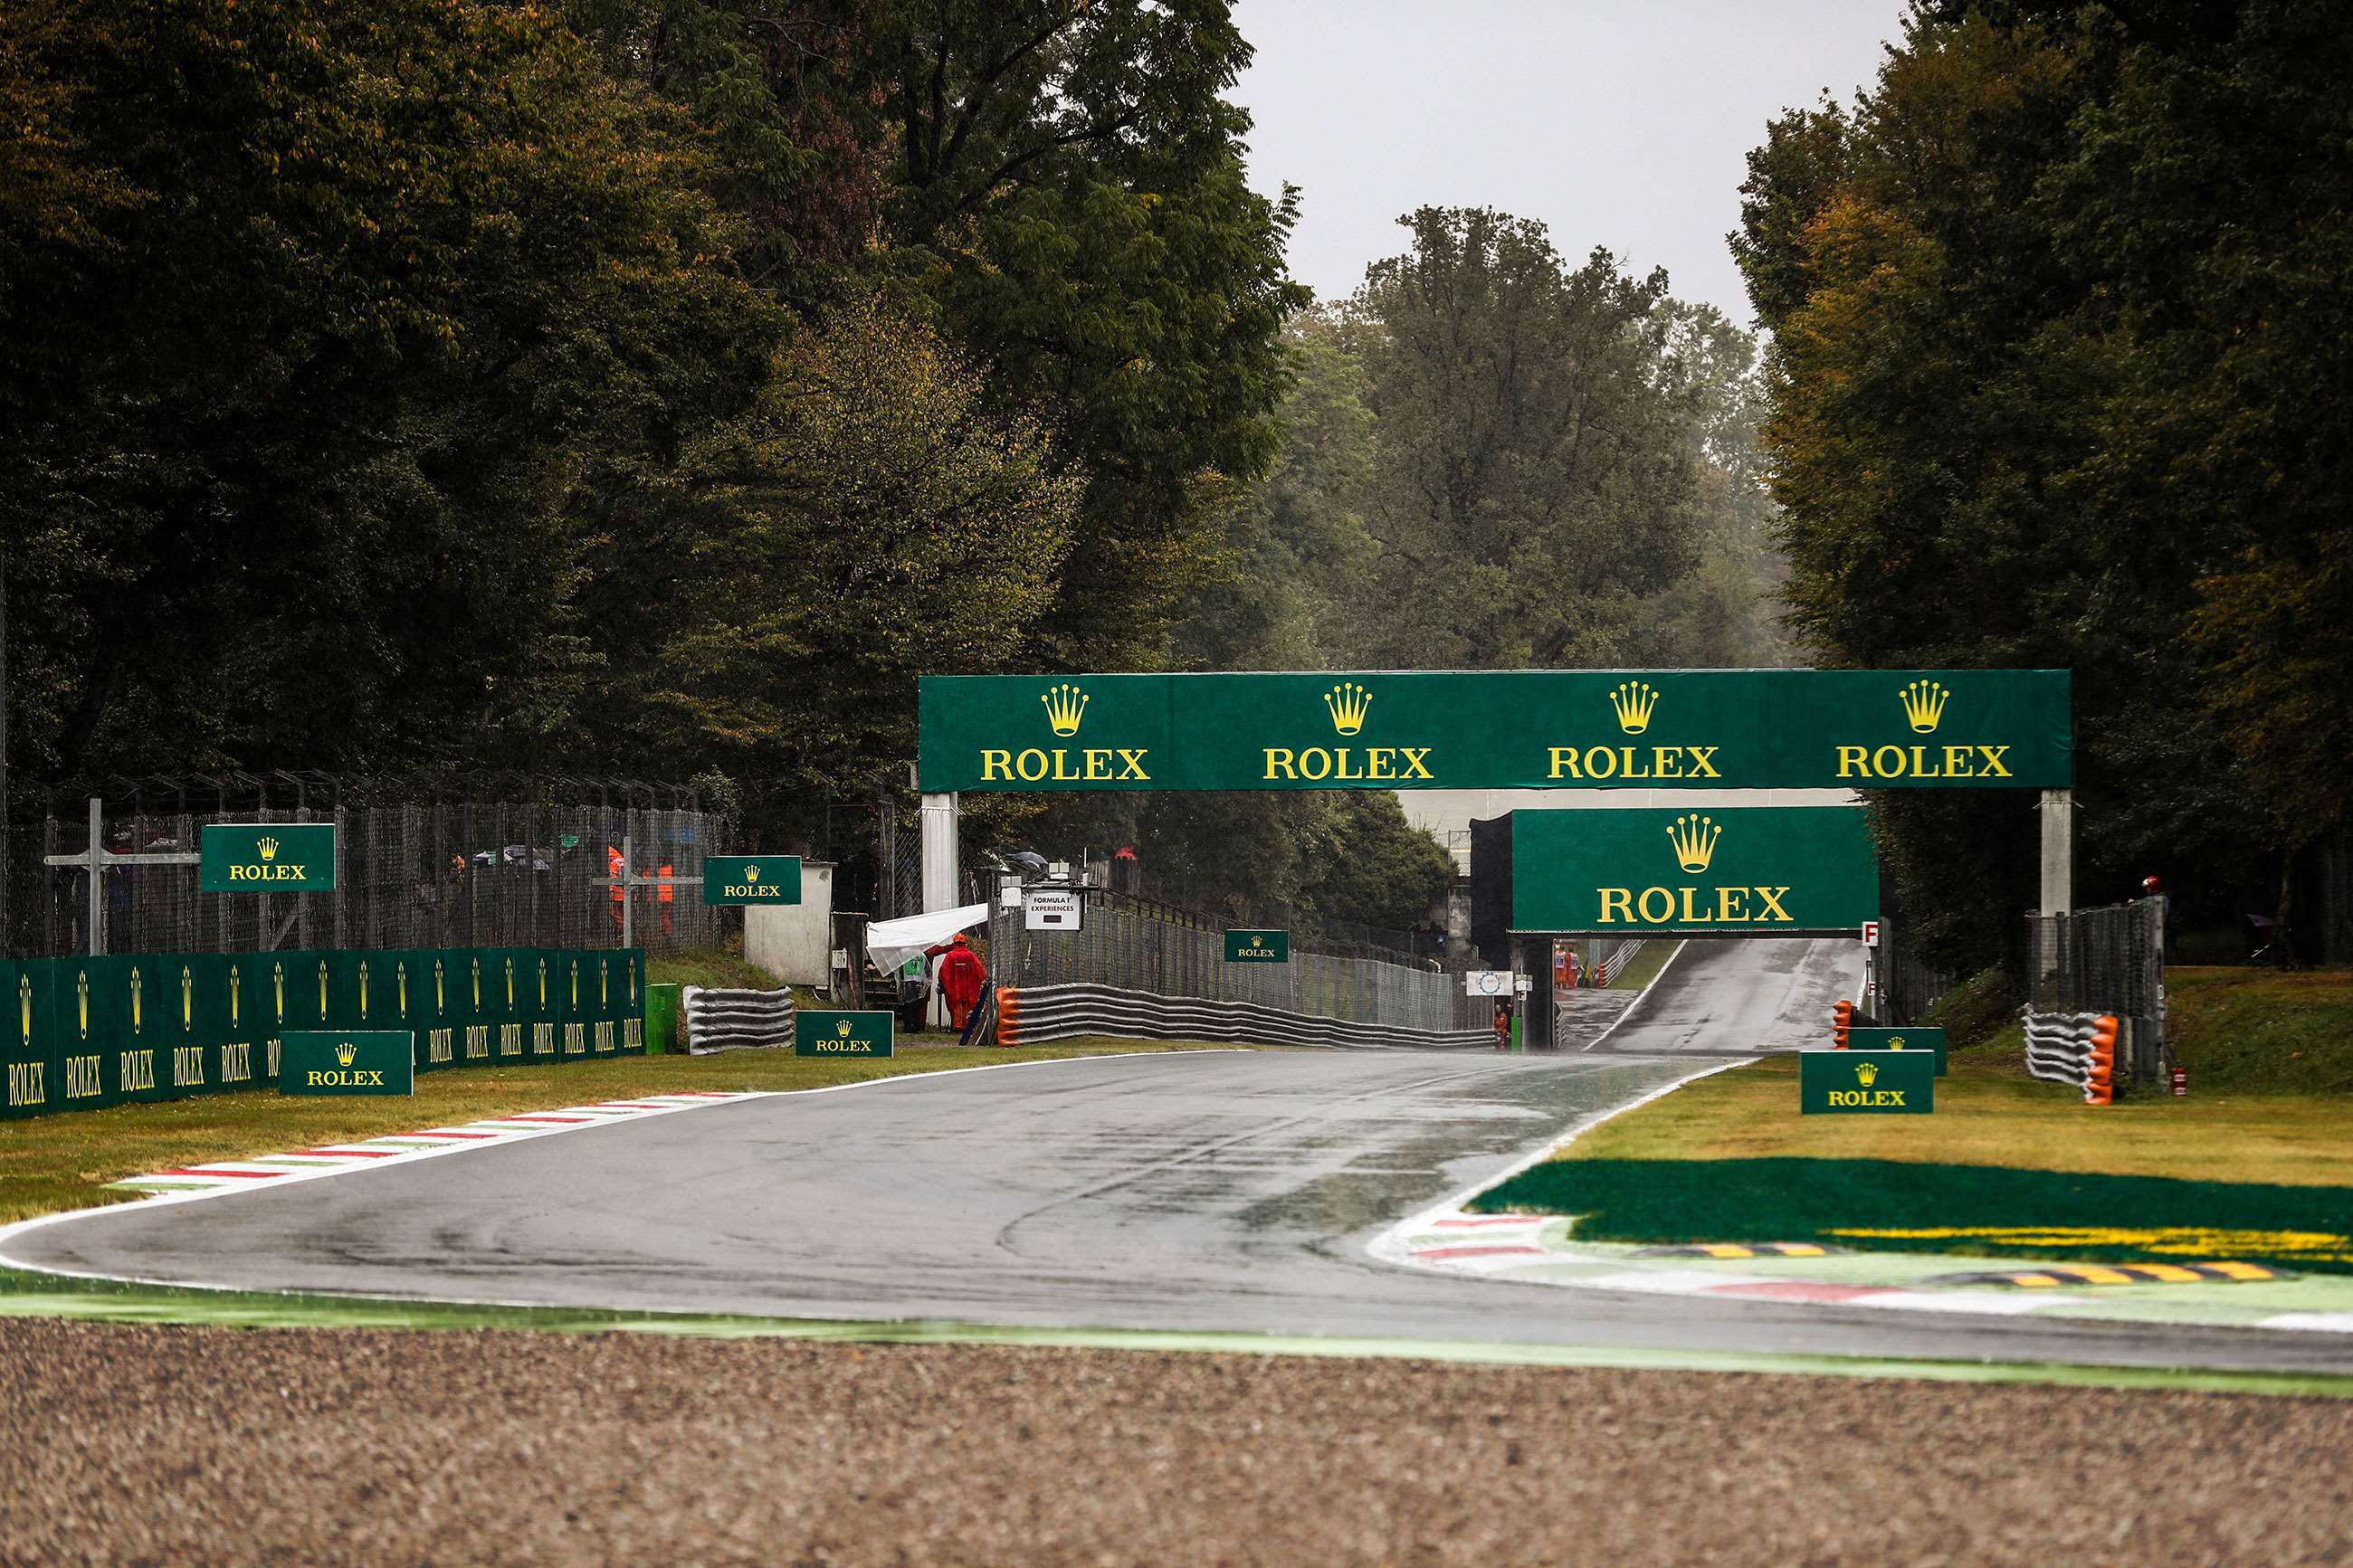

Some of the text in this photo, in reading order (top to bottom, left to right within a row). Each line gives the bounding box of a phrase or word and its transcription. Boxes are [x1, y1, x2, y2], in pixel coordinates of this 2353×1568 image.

[981, 748, 1151, 782] ROLEX
[1263, 746, 1434, 781] ROLEX
[1548, 746, 1722, 779] ROLEX
[1835, 745, 2014, 778] ROLEX
[229, 865, 306, 880] ROLEX
[724, 885, 780, 897] ROLEX
[1596, 886, 1794, 924] ROLEX
[1865, 924, 1880, 943] F
[1237, 948, 1274, 957] ROLEX
[429, 1027, 452, 1063] ROLEX
[466, 1025, 489, 1059] ROLEX
[500, 1023, 522, 1057] ROLEX
[533, 1022, 554, 1055] ROLEX
[565, 1022, 586, 1054] ROLEX
[595, 1021, 615, 1052] ROLEX
[624, 1018, 643, 1049] ROLEX
[815, 1040, 872, 1052] ROLEX
[66, 1055, 101, 1098] ROLEX
[120, 1049, 155, 1092] ROLEX
[173, 1046, 205, 1087] ROLEX
[221, 1042, 252, 1083] ROLEX
[307, 1070, 385, 1087] ROLEX
[8, 1061, 45, 1107] ROLEX
[1828, 1090, 1906, 1107] ROLEX
